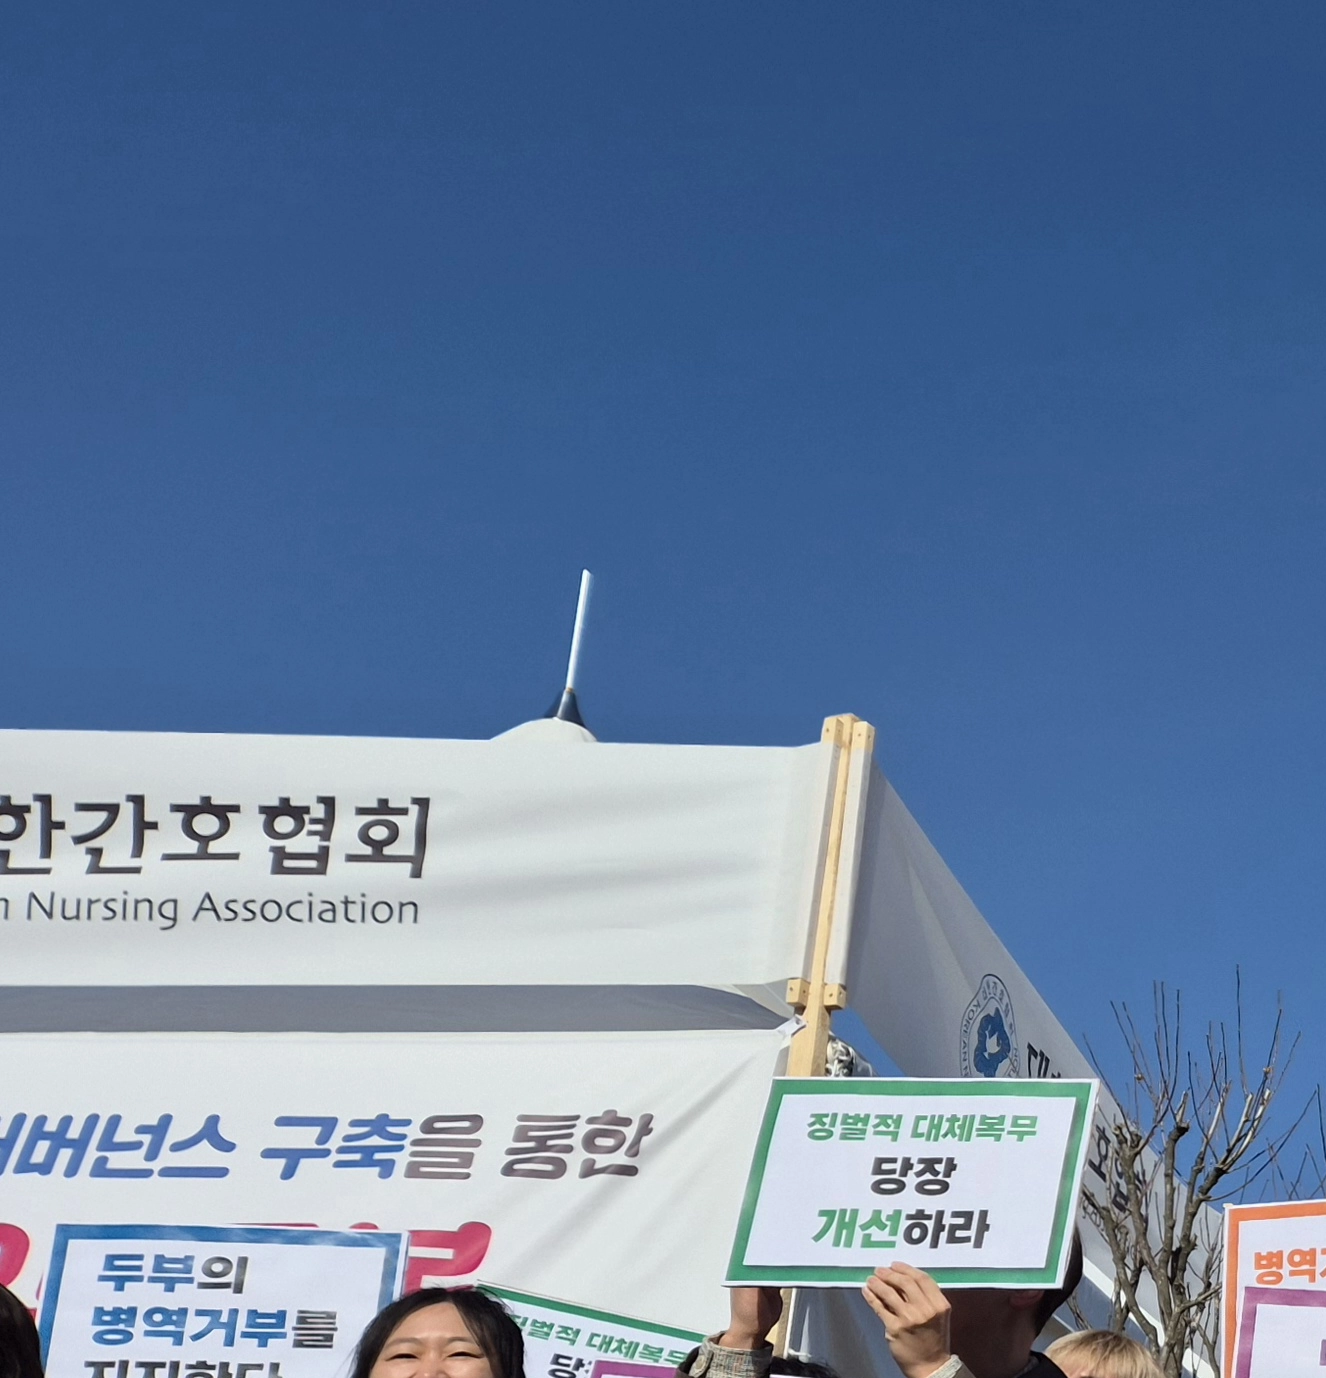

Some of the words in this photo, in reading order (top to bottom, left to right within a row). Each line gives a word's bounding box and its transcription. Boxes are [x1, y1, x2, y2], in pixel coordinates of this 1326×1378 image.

[27, 891, 179, 930] Nursing
[192, 892, 419, 925] Association
[260, 1113, 484, 1180] 구축을
[500, 1110, 654, 1179] 통한
[806, 1112, 900, 1142] 징벌적
[910, 1112, 1039, 1144] 대체복무
[868, 1155, 957, 1196] 당장
[811, 1209, 991, 1250] 개선하라
[98, 1254, 248, 1294] 두부의
[90, 1306, 338, 1348] 병역거부를
